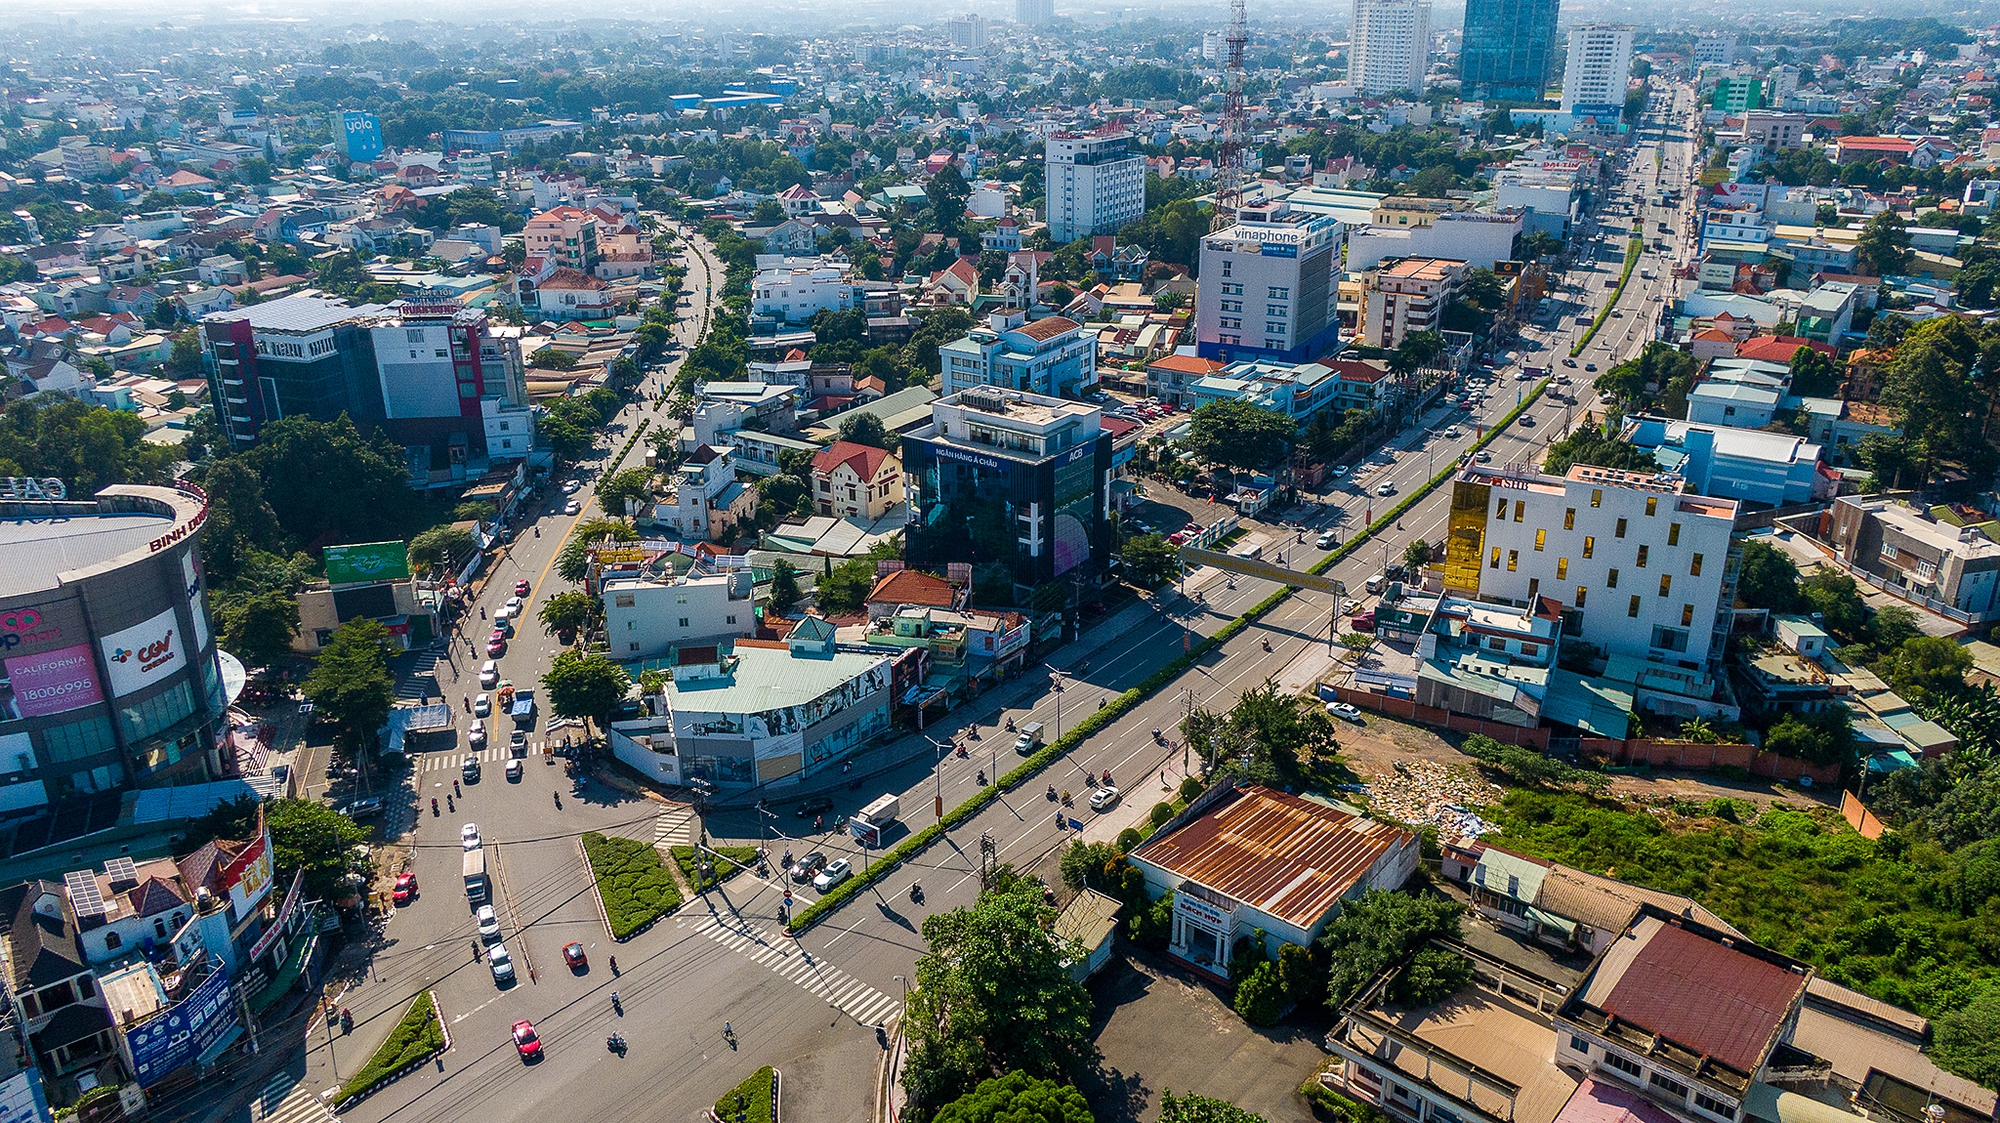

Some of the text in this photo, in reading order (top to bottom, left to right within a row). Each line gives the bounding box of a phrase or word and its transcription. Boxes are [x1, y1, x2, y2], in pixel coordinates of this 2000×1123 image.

[346, 117, 373, 133] yola
[1234, 228, 1298, 242] vinaphone
[935, 448, 954, 458] NGÂN
[1068, 448, 1083, 462] ACB
[22, 627, 61, 644] mart
[138, 630, 173, 663] CGV
[15, 656, 85, 675] CALIFORNIA
[141, 652, 175, 672] CINEMAS
